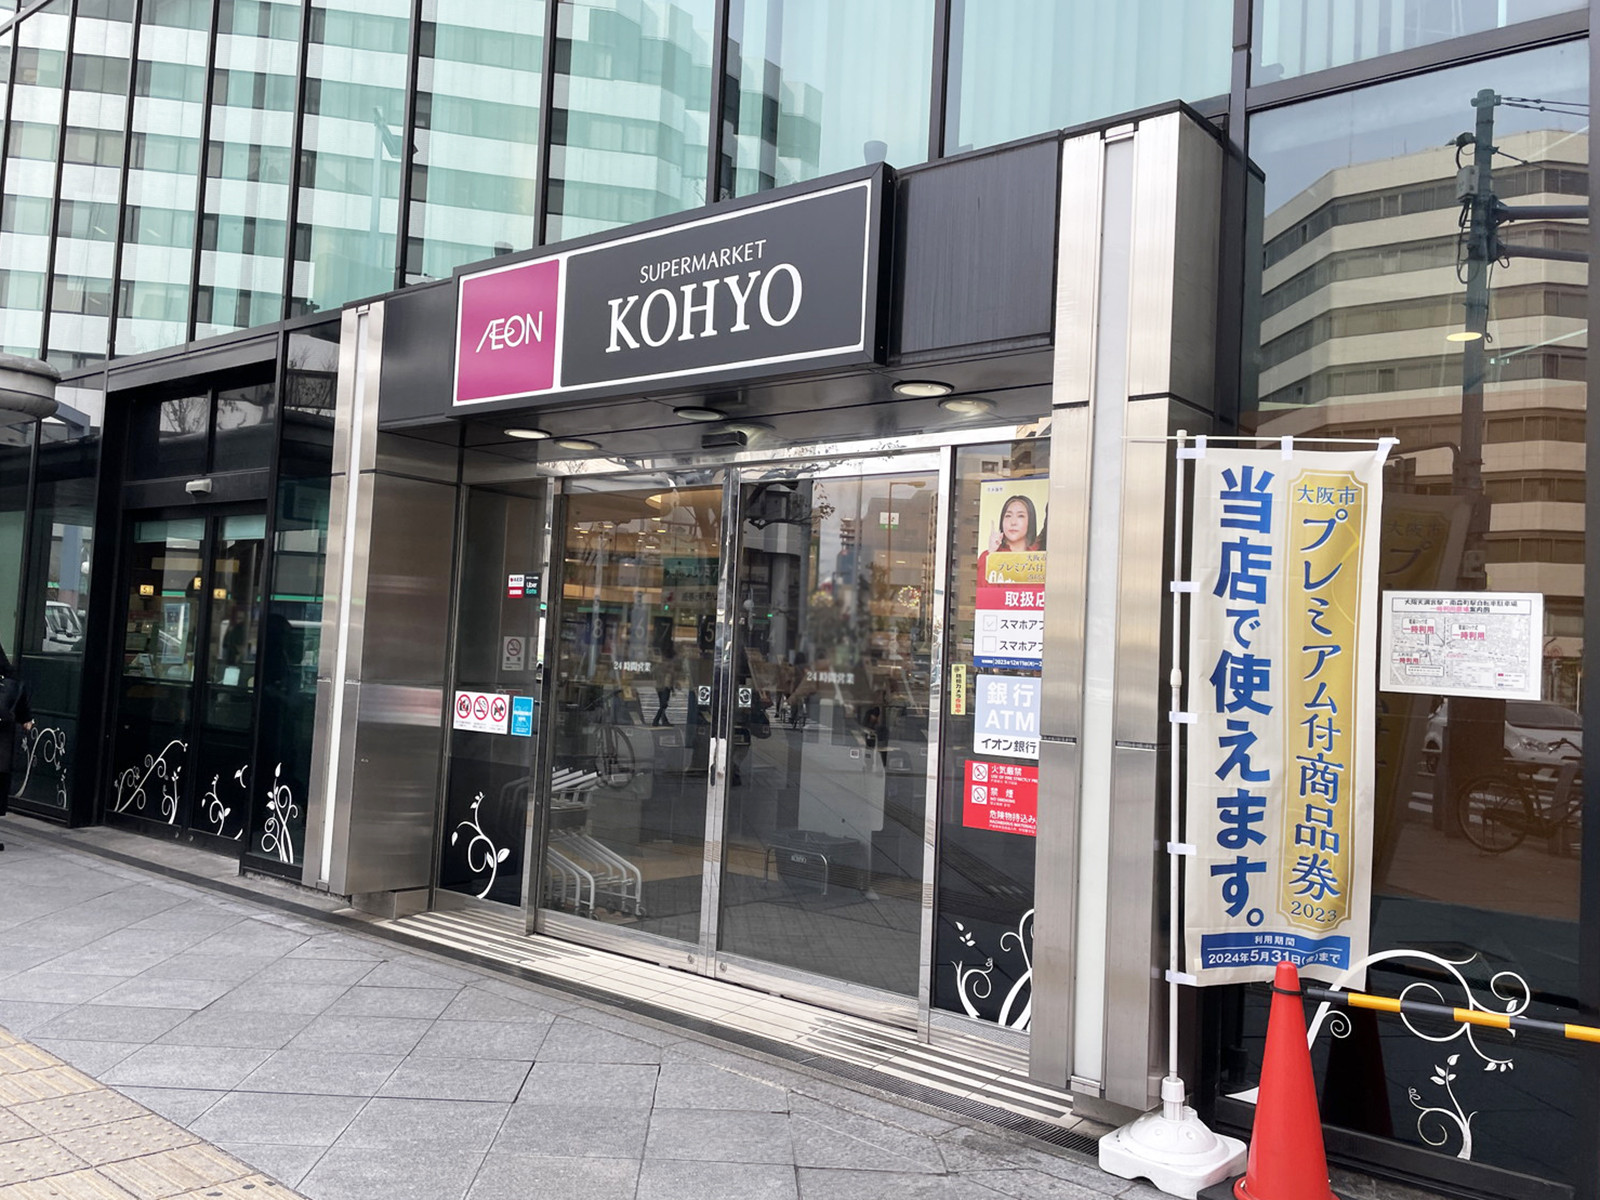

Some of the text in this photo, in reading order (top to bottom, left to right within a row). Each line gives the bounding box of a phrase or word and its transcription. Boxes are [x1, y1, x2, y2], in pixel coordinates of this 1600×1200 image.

[639, 239, 767, 284] SUPERMARKET
[605, 263, 803, 354] KOHYO
[1297, 484, 1359, 506] 大阪市
[986, 681, 1034, 708] 銀行
[1209, 465, 1275, 927] 当店で使えます。
[1289, 508, 1348, 901] プレミアム付商品券
[984, 708, 1035, 732] ATM
[981, 738, 1037, 754] イオン銀行
[1290, 900, 1338, 923] 2023
[1254, 935, 1296, 947] 利用期間
